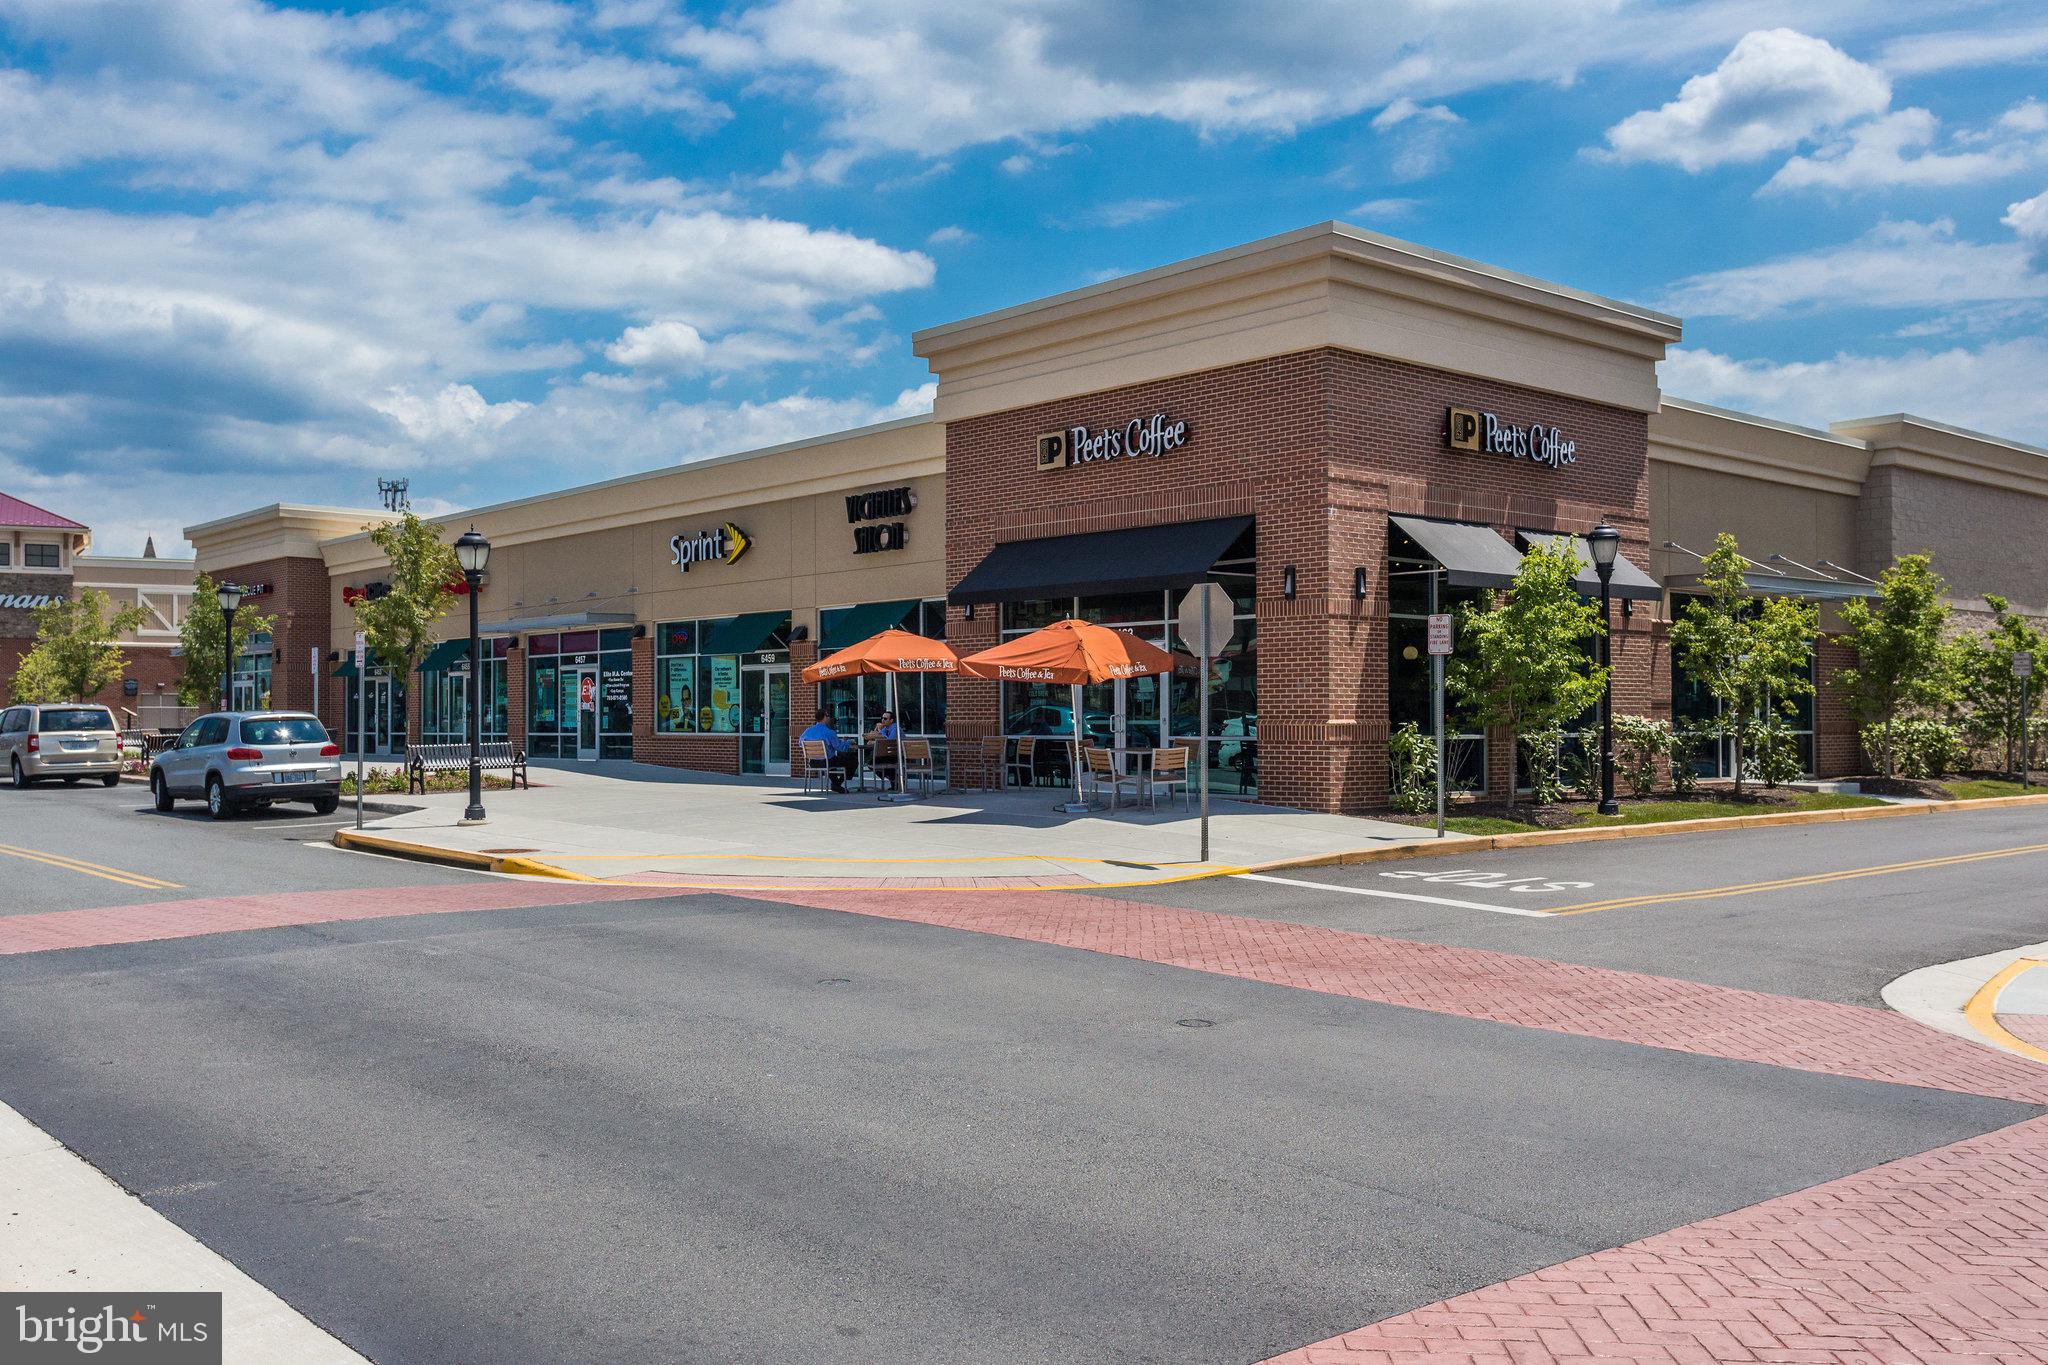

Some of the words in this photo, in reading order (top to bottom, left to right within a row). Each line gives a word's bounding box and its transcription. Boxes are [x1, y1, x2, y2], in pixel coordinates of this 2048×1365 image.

[1071, 426, 1121, 465] Peet's
[1125, 413, 1186, 457] Coffee
[1484, 413, 1527, 458] Peet's
[1530, 424, 1576, 469] Coffee
[670, 528, 726, 573] Sprint
[575, 655, 586, 664] 6457
[761, 653, 776, 663] 6459
[915, 657, 936, 670] Coffee
[936, 660, 942, 668] &
[940, 657, 954, 669] Tea
[1136, 661, 1148, 672] Tea
[1016, 667, 1037, 680] Coffee
[1042, 668, 1055, 680] Tea
[1378, 869, 1595, 893] STOP
